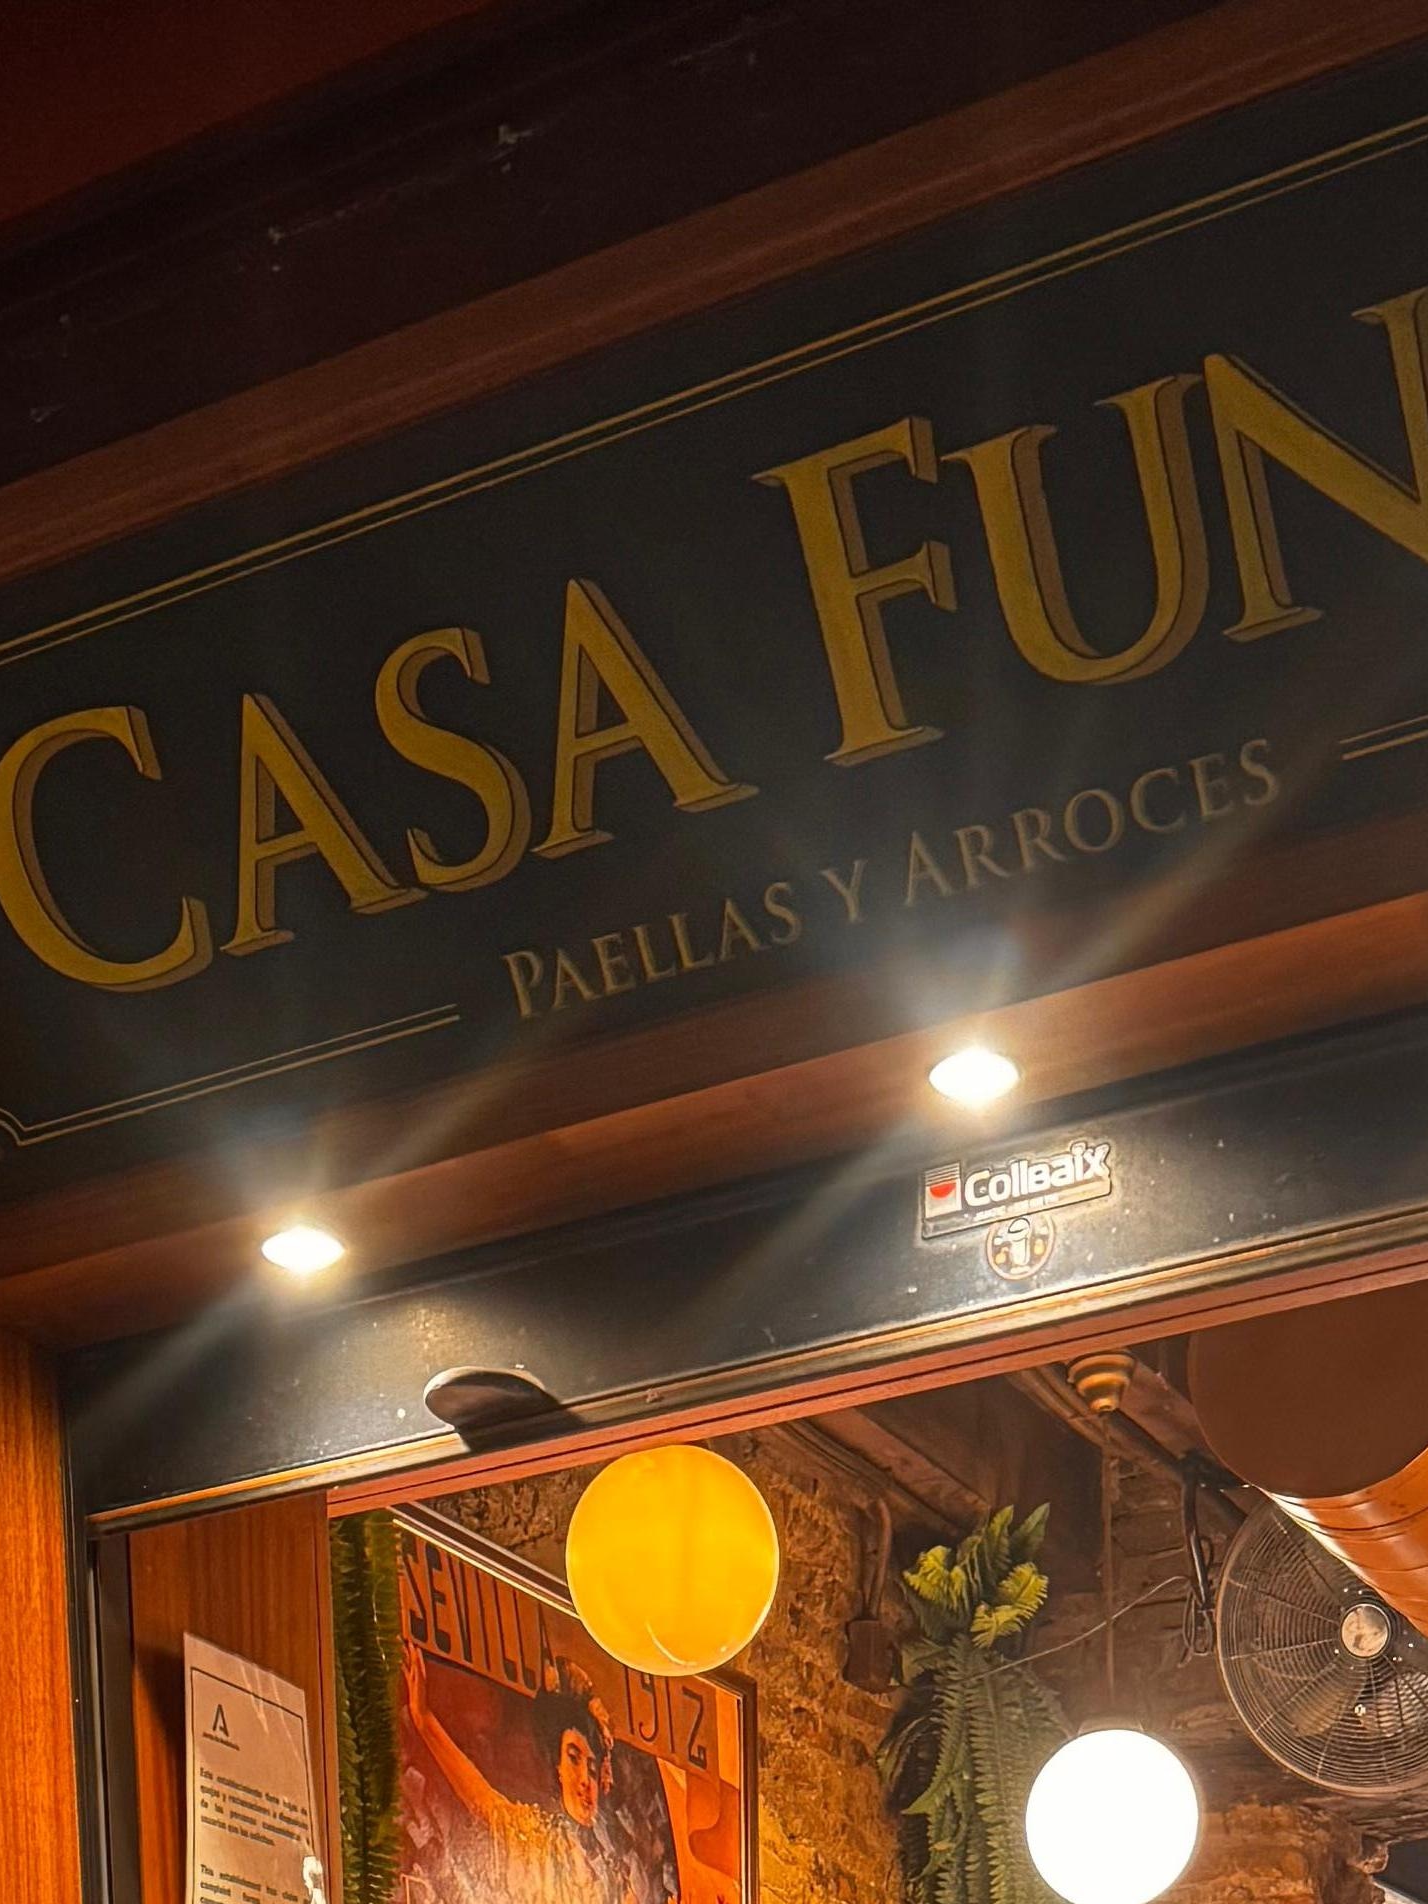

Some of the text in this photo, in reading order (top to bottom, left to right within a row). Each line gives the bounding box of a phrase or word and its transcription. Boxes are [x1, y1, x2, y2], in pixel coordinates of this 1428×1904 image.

[502, 738, 1283, 1020] PAELLAS Y ARROCES
